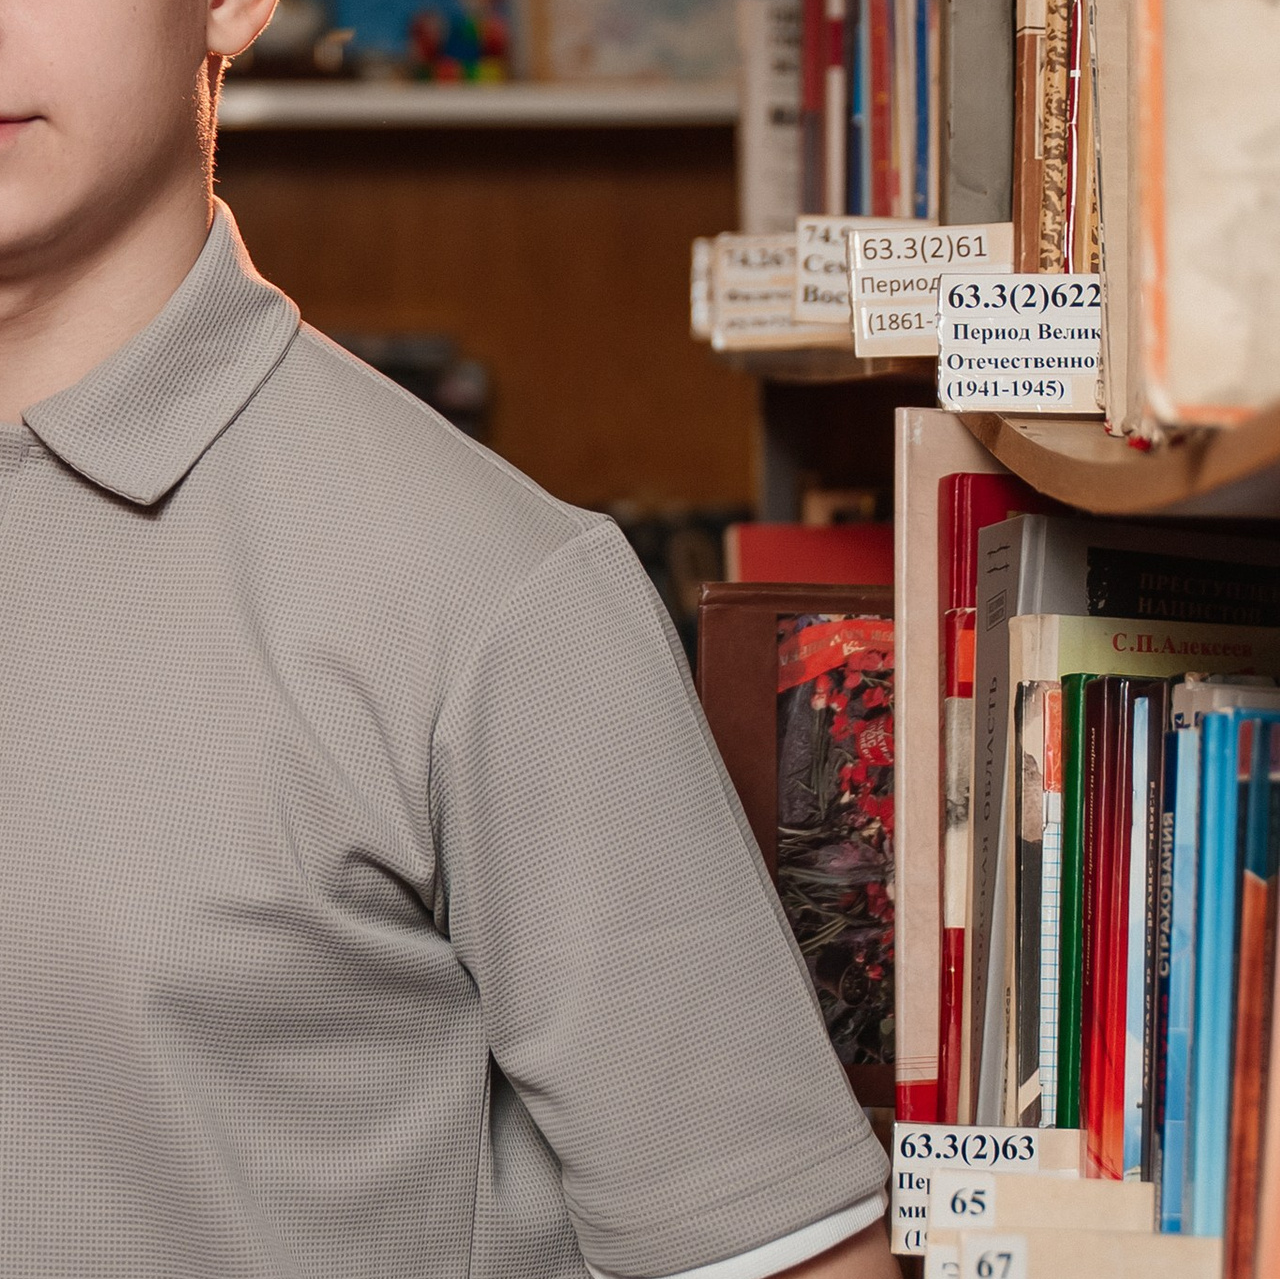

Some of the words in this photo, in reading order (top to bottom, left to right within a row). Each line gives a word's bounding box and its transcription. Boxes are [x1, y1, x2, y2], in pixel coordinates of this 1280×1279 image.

[862, 234, 987, 264] 63.3(2)61
[947, 283, 1101, 315] 63.3(2)622
[953, 325, 1030, 344] Период
[946, 379, 1065, 401] (1941-1945)
[982, 675, 998, 822] ОБЛАСТЬ
[1158, 811, 1174, 978] СТРАХОВАНИЯ
[900, 1132, 1035, 1167] 63.3(2)63
[950, 1187, 987, 1216] 65
